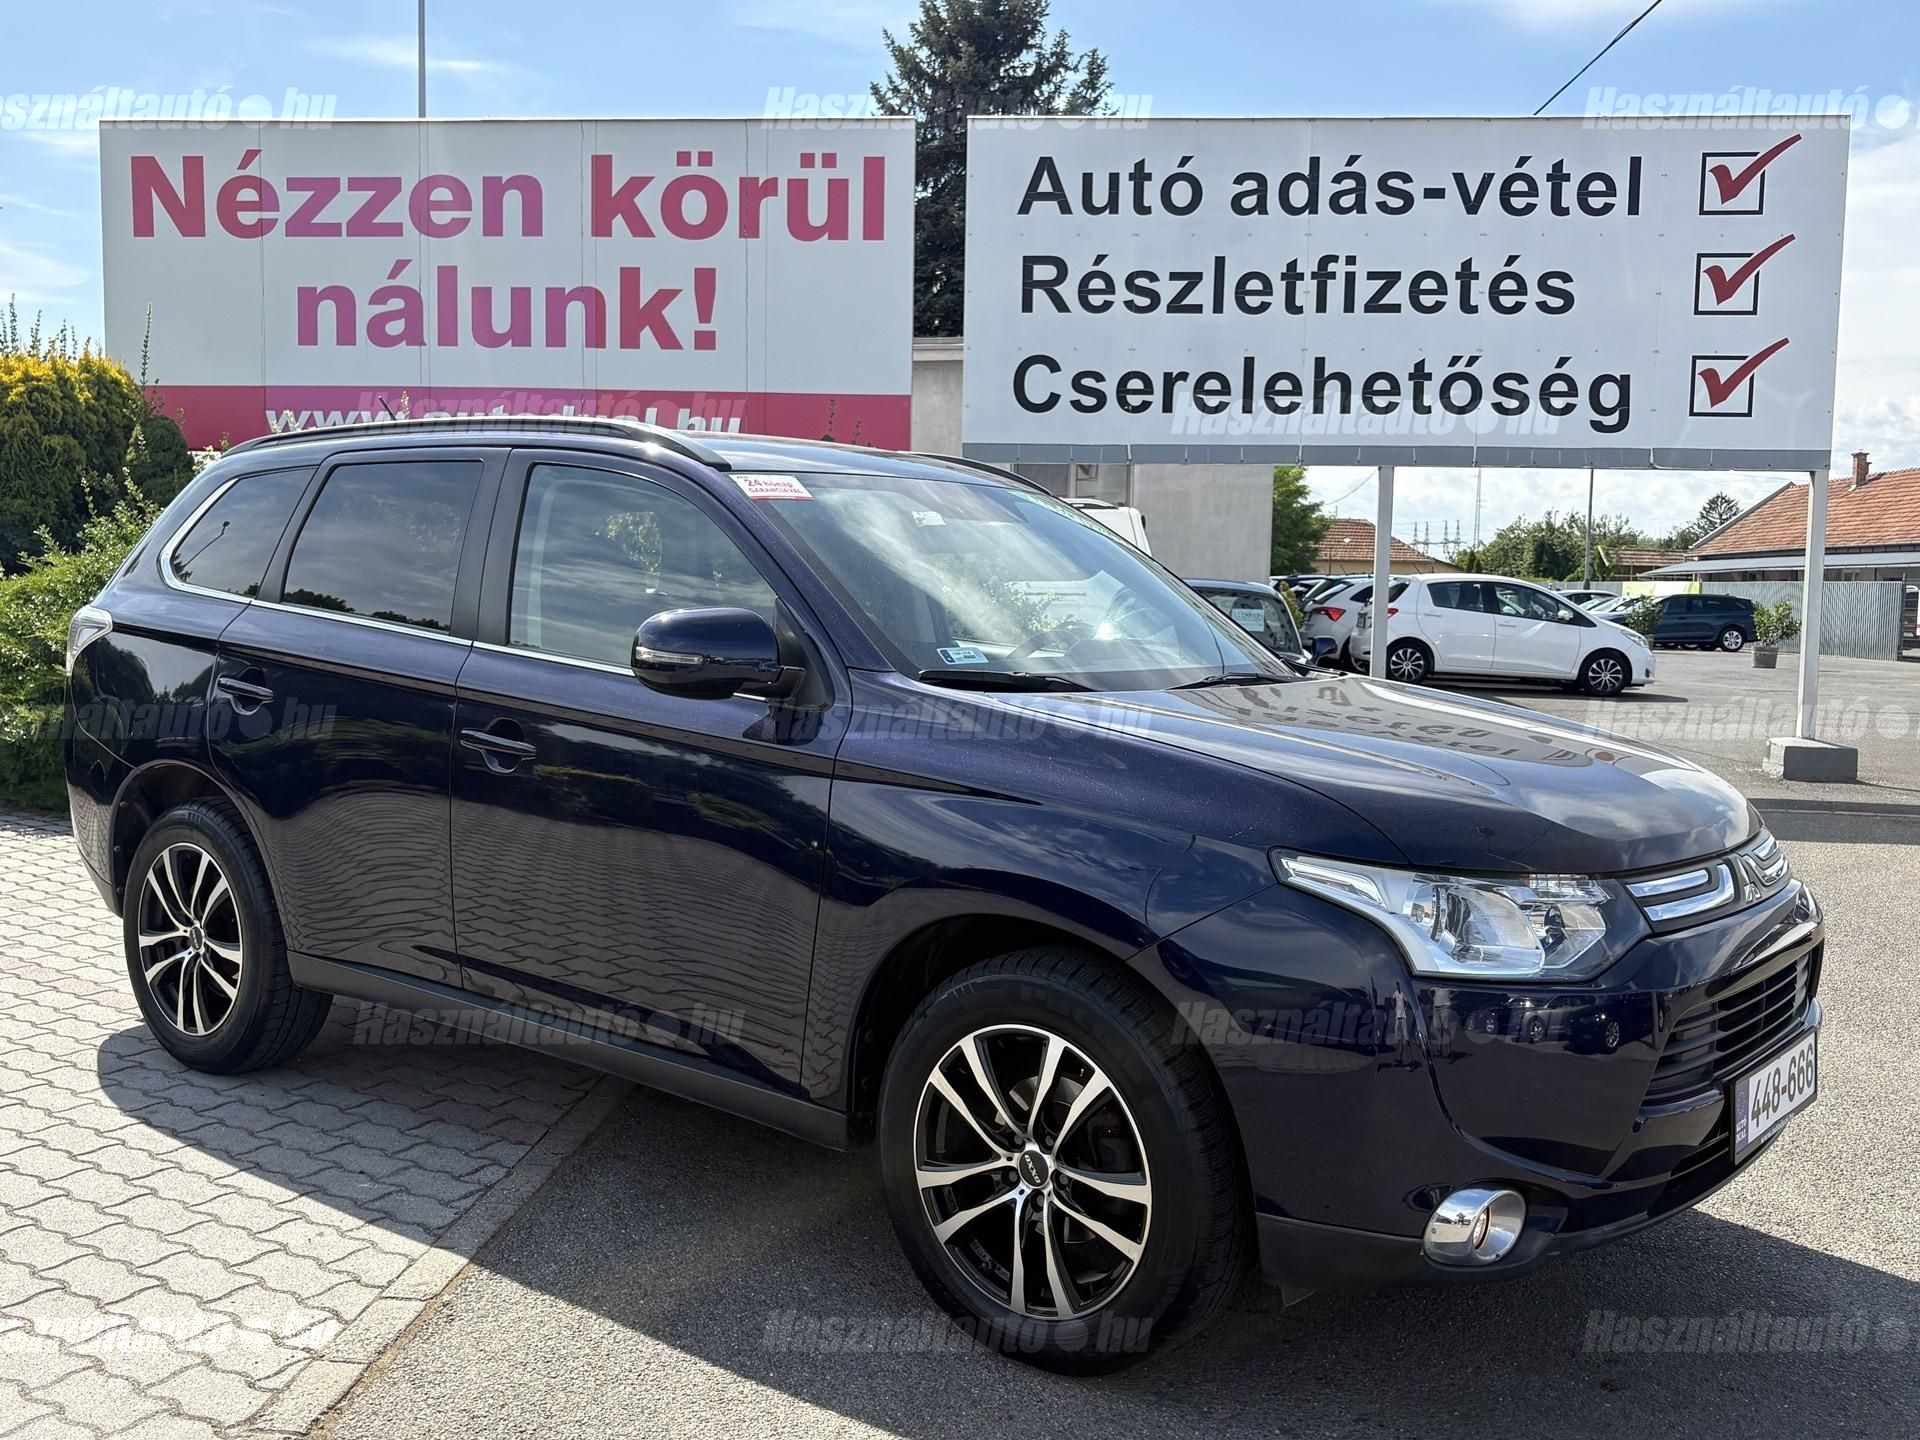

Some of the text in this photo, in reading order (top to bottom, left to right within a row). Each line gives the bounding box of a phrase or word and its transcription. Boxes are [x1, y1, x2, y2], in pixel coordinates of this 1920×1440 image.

[130, 149, 885, 241] Nézzen körül
[1018, 154, 1642, 217] Autó adás-vétel
[298, 260, 716, 350] nálunk!
[1021, 254, 1575, 315] Részletfizetés
[1013, 354, 1631, 434] Cserelehetőség
[1751, 1042, 1814, 1128] 448-666
